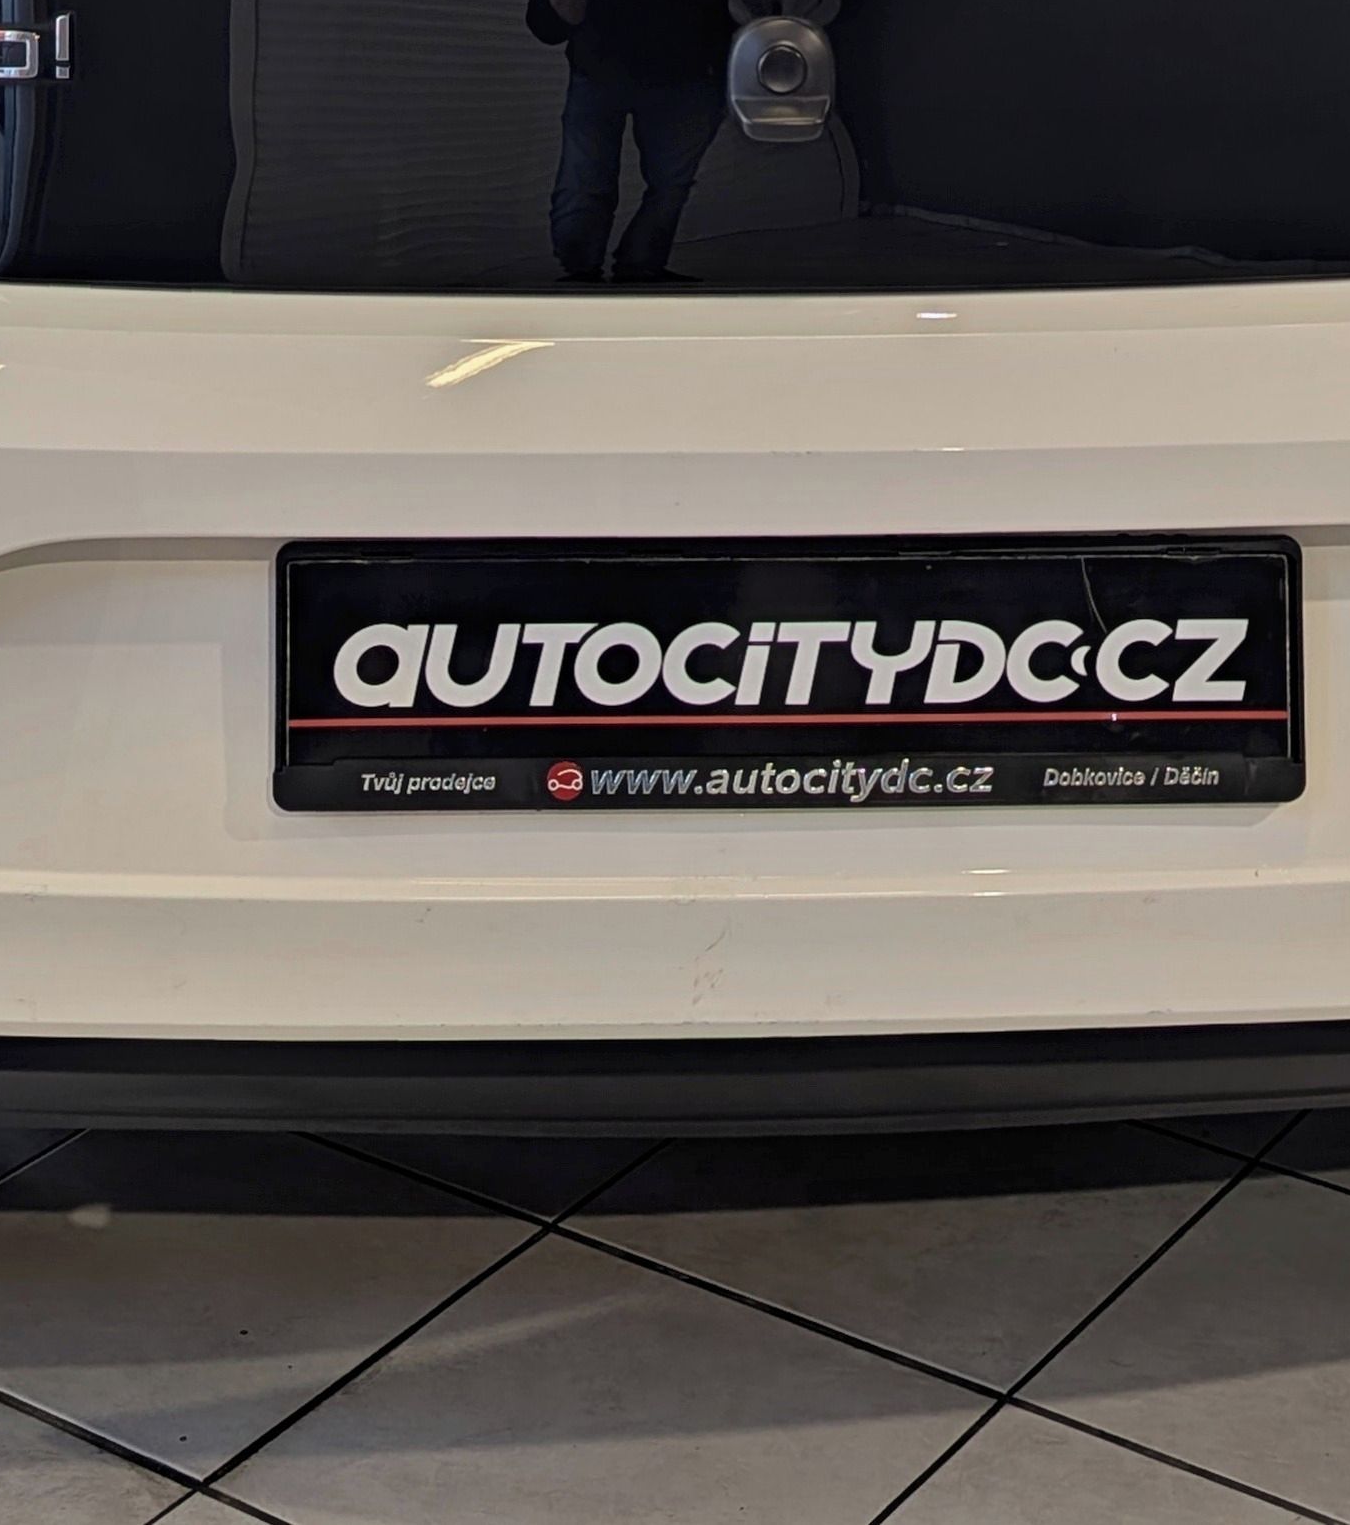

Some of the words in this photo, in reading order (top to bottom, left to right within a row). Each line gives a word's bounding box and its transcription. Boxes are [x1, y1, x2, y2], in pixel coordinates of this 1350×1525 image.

[361, 772, 401, 794] Tvůj
[590, 758, 994, 803] www.autocitydc.cz
[1044, 766, 1146, 787] Dobkovice
